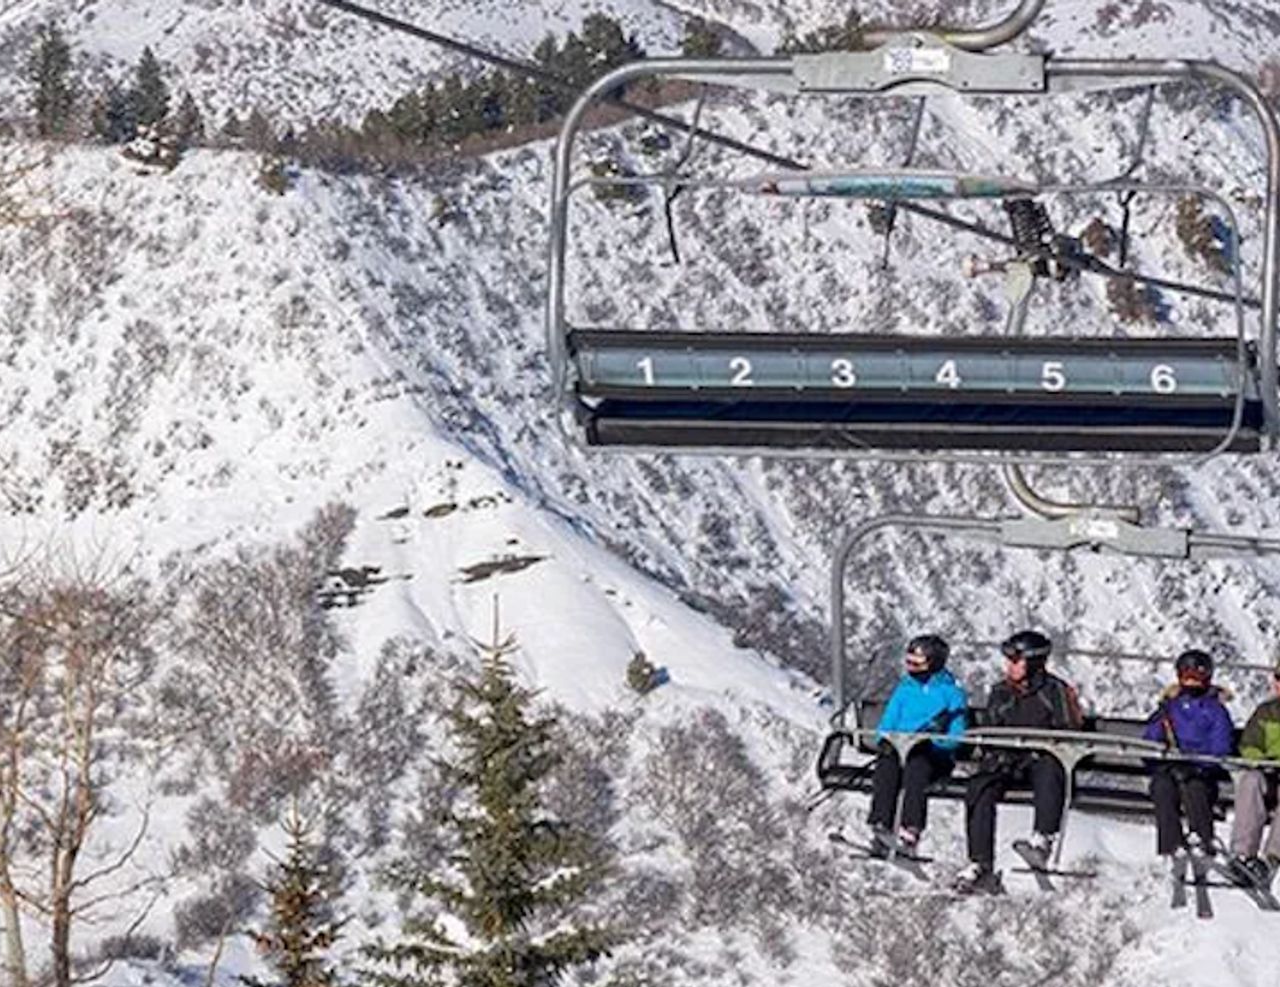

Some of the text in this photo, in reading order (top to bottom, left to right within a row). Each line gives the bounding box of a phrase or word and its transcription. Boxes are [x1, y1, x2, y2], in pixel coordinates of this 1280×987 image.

[638, 358, 1176, 393] 1 2 3 4 5 6
